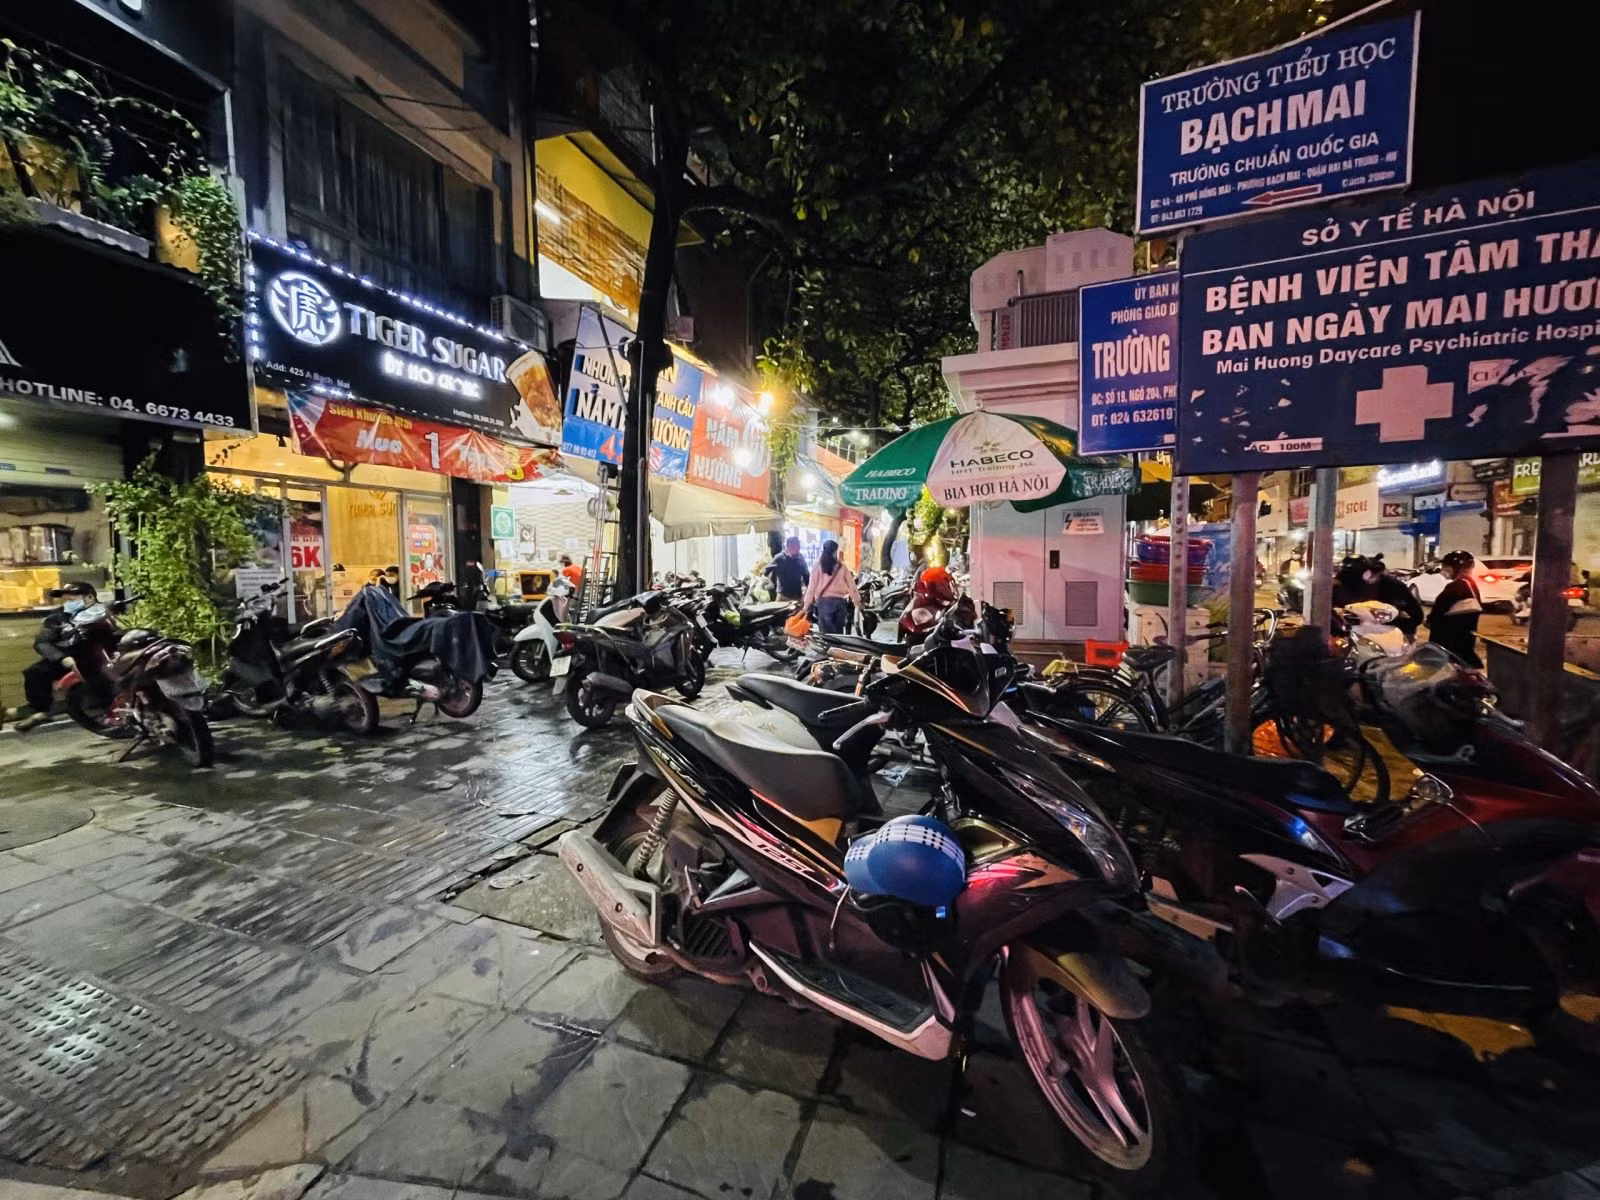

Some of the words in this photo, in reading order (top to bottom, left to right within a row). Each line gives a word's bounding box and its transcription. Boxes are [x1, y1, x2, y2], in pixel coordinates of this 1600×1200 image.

[1162, 72, 1262, 114] TRƯỜNG
[1266, 46, 1331, 88] TIỂU
[1337, 37, 1396, 70] HỌC
[1170, 163, 1230, 187] TRƯỜNG
[1234, 143, 1291, 173] CHUẨN
[1296, 133, 1345, 160] QUỐC
[1349, 131, 1379, 150] GIA
[1302, 217, 1340, 246] SỞ
[1350, 219, 1370, 237] Y
[1379, 202, 1416, 231] TẾ
[1424, 196, 1466, 226] HÀ
[1477, 190, 1535, 218] NỘI
[1134, 282, 1147, 301] ỦY
[1149, 283, 1169, 299] BAN
[1205, 274, 1302, 316] BỆNH
[1316, 254, 1408, 299] VIỆN
[1424, 239, 1519, 281] TÂM
[1145, 300, 1167, 319] GIÁO
[1169, 301, 1179, 316] D
[1202, 321, 1274, 356] BAN
[1286, 302, 1392, 345] NGÀY
[1404, 290, 1487, 331] MAI
[1503, 278, 1600, 318] HƯƠ
[342, 302, 428, 358] TIGER
[431, 336, 507, 384] SUGAR
[1091, 328, 1170, 380] TRƯỜNG
[1216, 358, 1249, 374] Mai
[1254, 352, 1313, 371] Huong
[1319, 344, 1402, 365] Daycare
[1409, 327, 1529, 355] Psychiatric
[266, 360, 288, 372] Add:
[289, 367, 304, 377] 425
[0, 377, 103, 406] HOTLINE:
[110, 396, 140, 412] 04.
[146, 402, 190, 420] 6673
[194, 411, 235, 427] 4433
[1110, 410, 1130, 426] 024
[1132, 406, 1177, 423] 632619
[425, 431, 441, 471] 1
[950, 449, 1034, 468] HABECO
[1279, 441, 1312, 451] 100M
[865, 467, 917, 478] HABECO
[944, 486, 967, 501] BIA
[998, 476, 1019, 493] HÀ
[855, 486, 908, 501] TRADING
[1345, 500, 1368, 514] STORE
